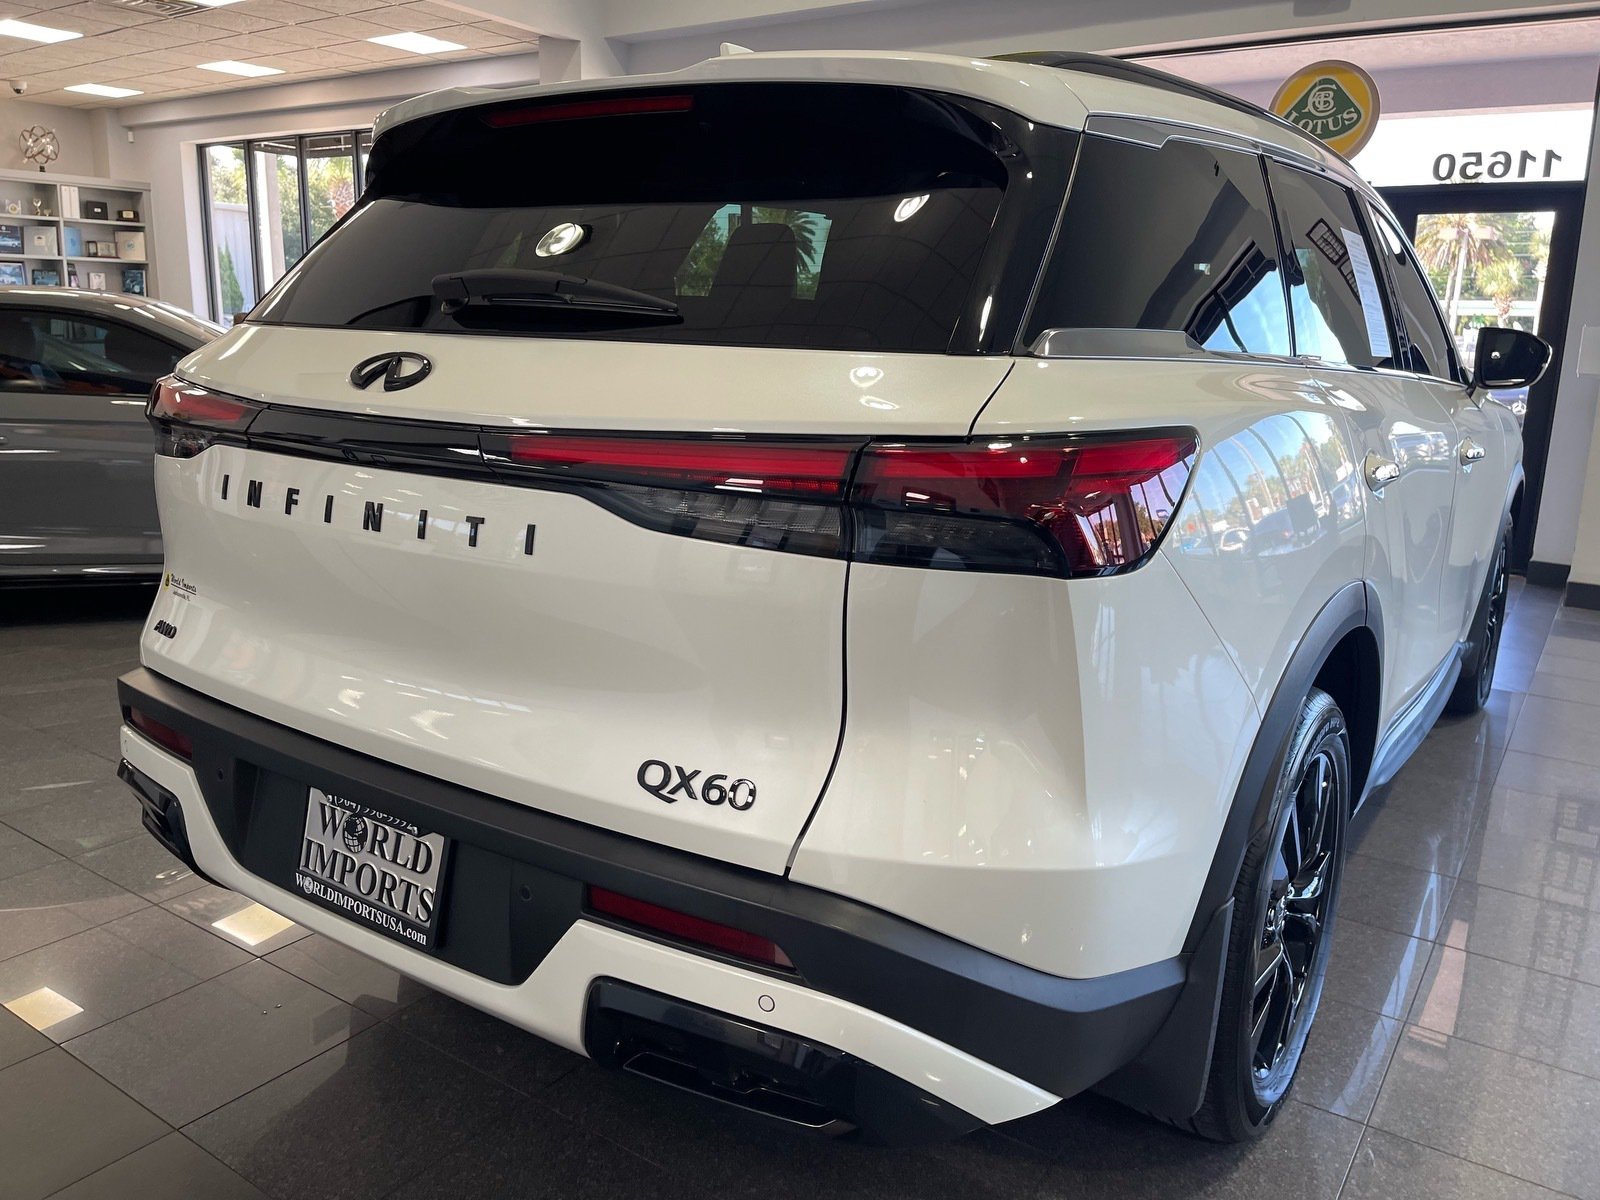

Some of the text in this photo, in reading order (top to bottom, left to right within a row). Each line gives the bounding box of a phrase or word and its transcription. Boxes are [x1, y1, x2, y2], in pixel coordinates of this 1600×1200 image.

[221, 474, 536, 556] INFINITI
[153, 619, 178, 639] AWD
[637, 759, 757, 811] QX60
[318, 801, 433, 875] WORLD
[302, 836, 435, 923] IMPORTS
